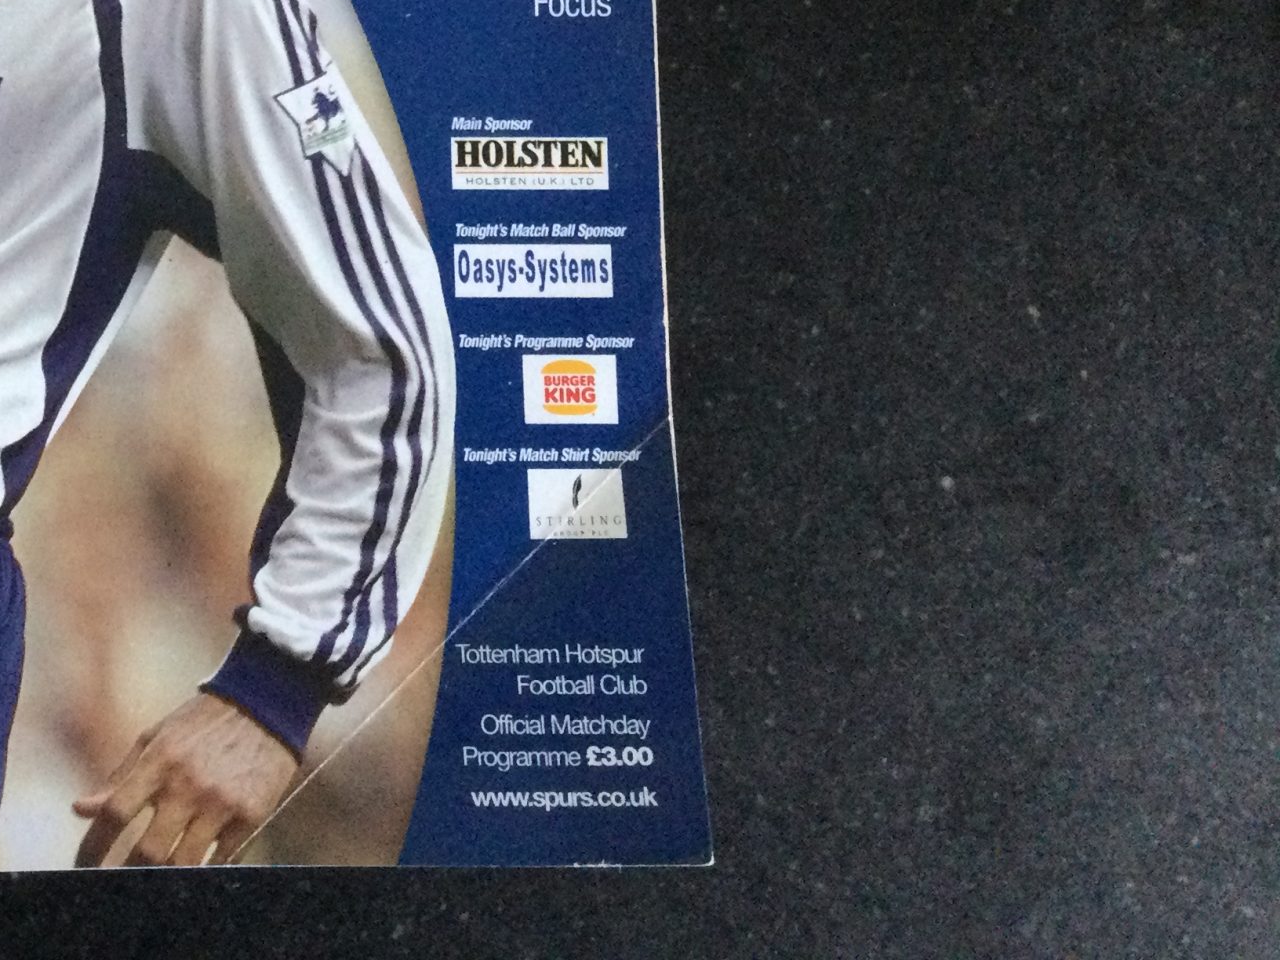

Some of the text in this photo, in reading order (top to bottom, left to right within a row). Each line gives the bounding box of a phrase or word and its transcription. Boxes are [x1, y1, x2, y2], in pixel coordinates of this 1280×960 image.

[451, 117, 533, 133] Main Sponsor
[455, 140, 604, 168] HOLSTEN
[466, 177, 527, 186] HOLSTEN
[570, 177, 595, 186] LTD
[455, 223, 627, 240] Tonight's Match Ball Sponsor
[458, 249, 610, 292] Oasys-Systems
[459, 334, 635, 351] Tonight's Programme Sponsor
[544, 375, 596, 387] BURGER
[544, 388, 596, 404] KING
[463, 448, 642, 465] Tonight's Match Shirt Sponsor
[536, 514, 622, 527] STIRLING
[455, 644, 645, 668] Tottenham Hotspur
[517, 674, 648, 695] Football Club
[481, 714, 651, 740] Official Matchday
[463, 746, 654, 772] Programme £3.00
[471, 787, 658, 812] www.spurs.co.uk
